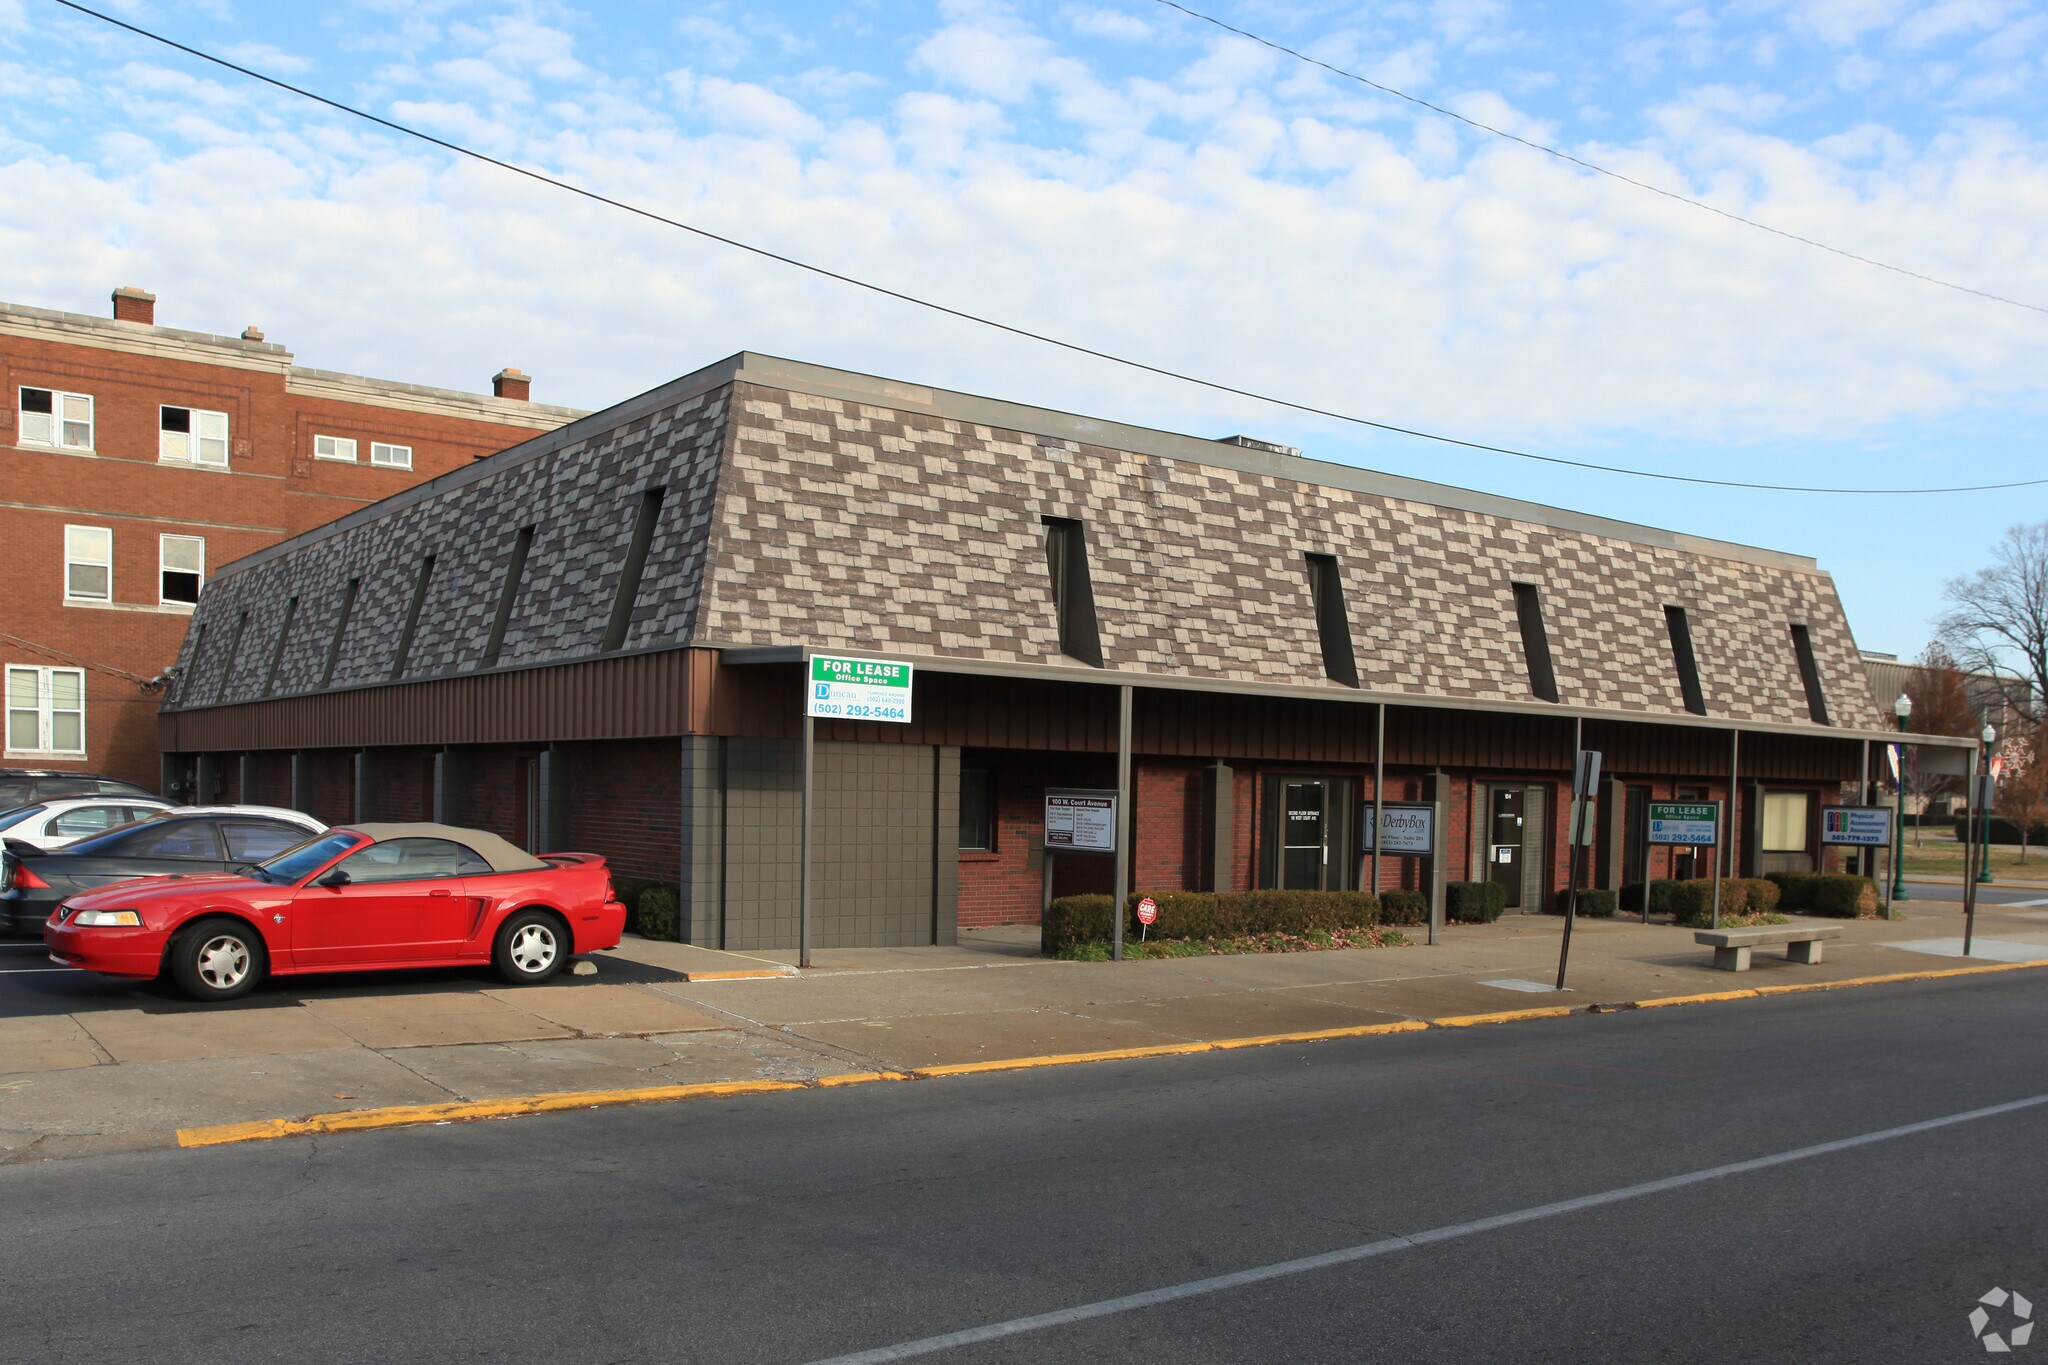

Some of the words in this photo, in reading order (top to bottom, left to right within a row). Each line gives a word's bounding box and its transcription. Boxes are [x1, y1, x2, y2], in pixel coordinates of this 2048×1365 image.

[823, 660, 852, 674] FOR
[856, 663, 900, 677] LEASE
[835, 673, 861, 682] Office
[863, 676, 888, 685] Space
[815, 683, 857, 699] Duncan
[813, 703, 842, 715] (502)
[846, 704, 905, 719] 292-5464
[1657, 806, 1676, 814] FOR
[1678, 807, 1708, 815] LEASE
[1383, 813, 1426, 833] DerbyBox
[1652, 833, 1670, 841] (502)
[1672, 833, 1712, 842] 292-5464
[1139, 903, 1156, 914] CARE
